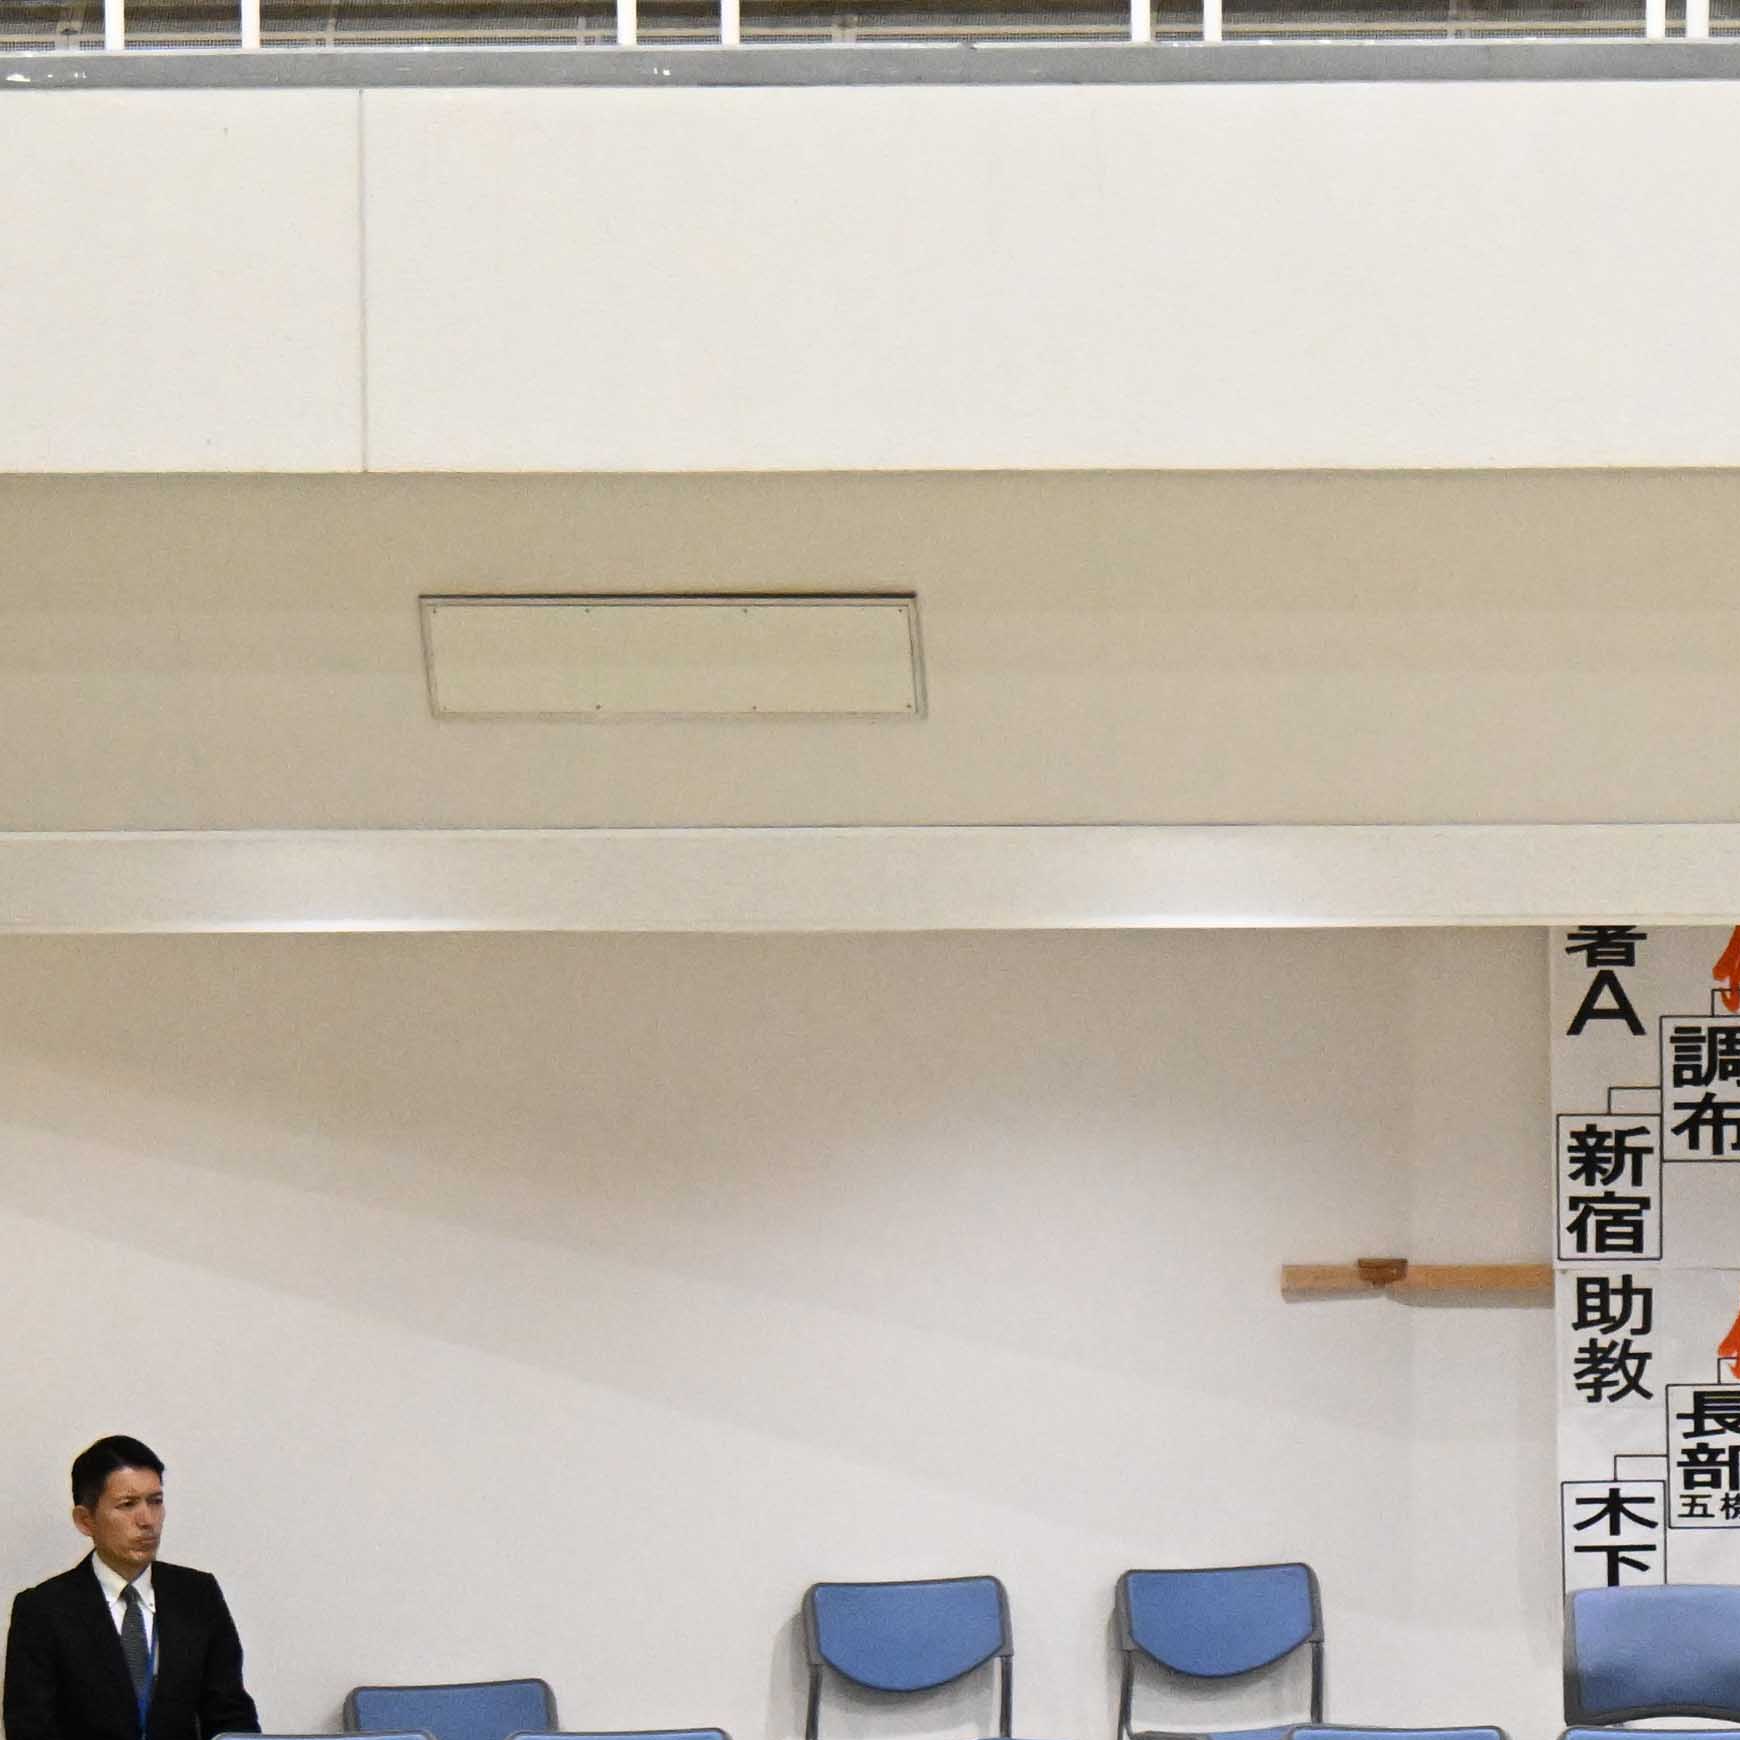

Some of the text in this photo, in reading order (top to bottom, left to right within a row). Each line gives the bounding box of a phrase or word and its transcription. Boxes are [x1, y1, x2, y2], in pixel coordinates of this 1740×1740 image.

[1564, 925, 1648, 1036] 者A
[1566, 1123, 1654, 1254] 新宿
[1571, 1273, 1653, 1403] 助教
[1573, 1487, 1659, 1586] 木下
